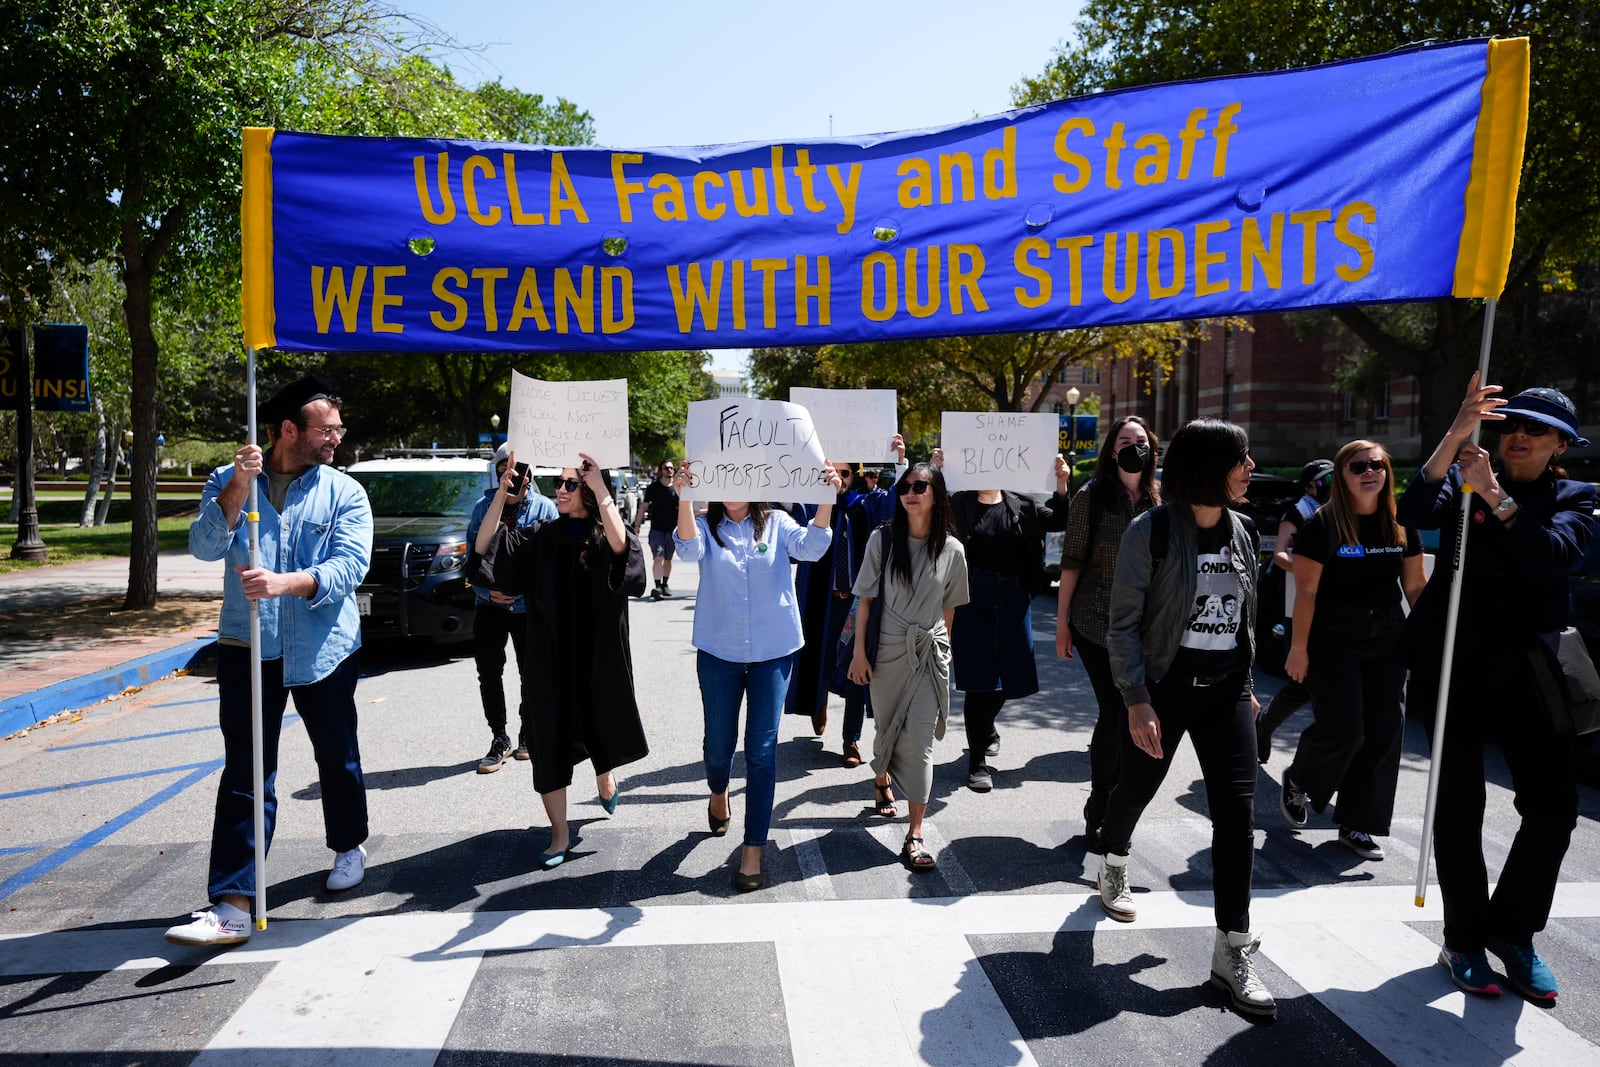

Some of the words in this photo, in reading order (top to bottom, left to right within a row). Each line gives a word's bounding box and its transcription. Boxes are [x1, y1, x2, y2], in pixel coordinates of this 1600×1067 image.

[414, 153, 588, 225] UCLA
[612, 147, 861, 233] Faculty
[898, 127, 1016, 208] and
[1054, 103, 1240, 192] Staff
[312, 266, 406, 333] WE
[431, 266, 634, 333] STAND
[668, 256, 830, 332] WITH
[862, 245, 988, 320] OUR
[1015, 202, 1375, 307] STUDENTS
[567, 410, 606, 423] NOT
[975, 414, 1028, 430] SHAME
[548, 428, 593, 441] WILL
[602, 427, 626, 440] NOT
[987, 433, 1009, 442] ON
[532, 439, 574, 457] REST
[961, 444, 1032, 475] BLOCK
[688, 459, 772, 492] SUPPORTS
[1340, 546, 1360, 554] UCLA
[1365, 546, 1385, 554] Labor
